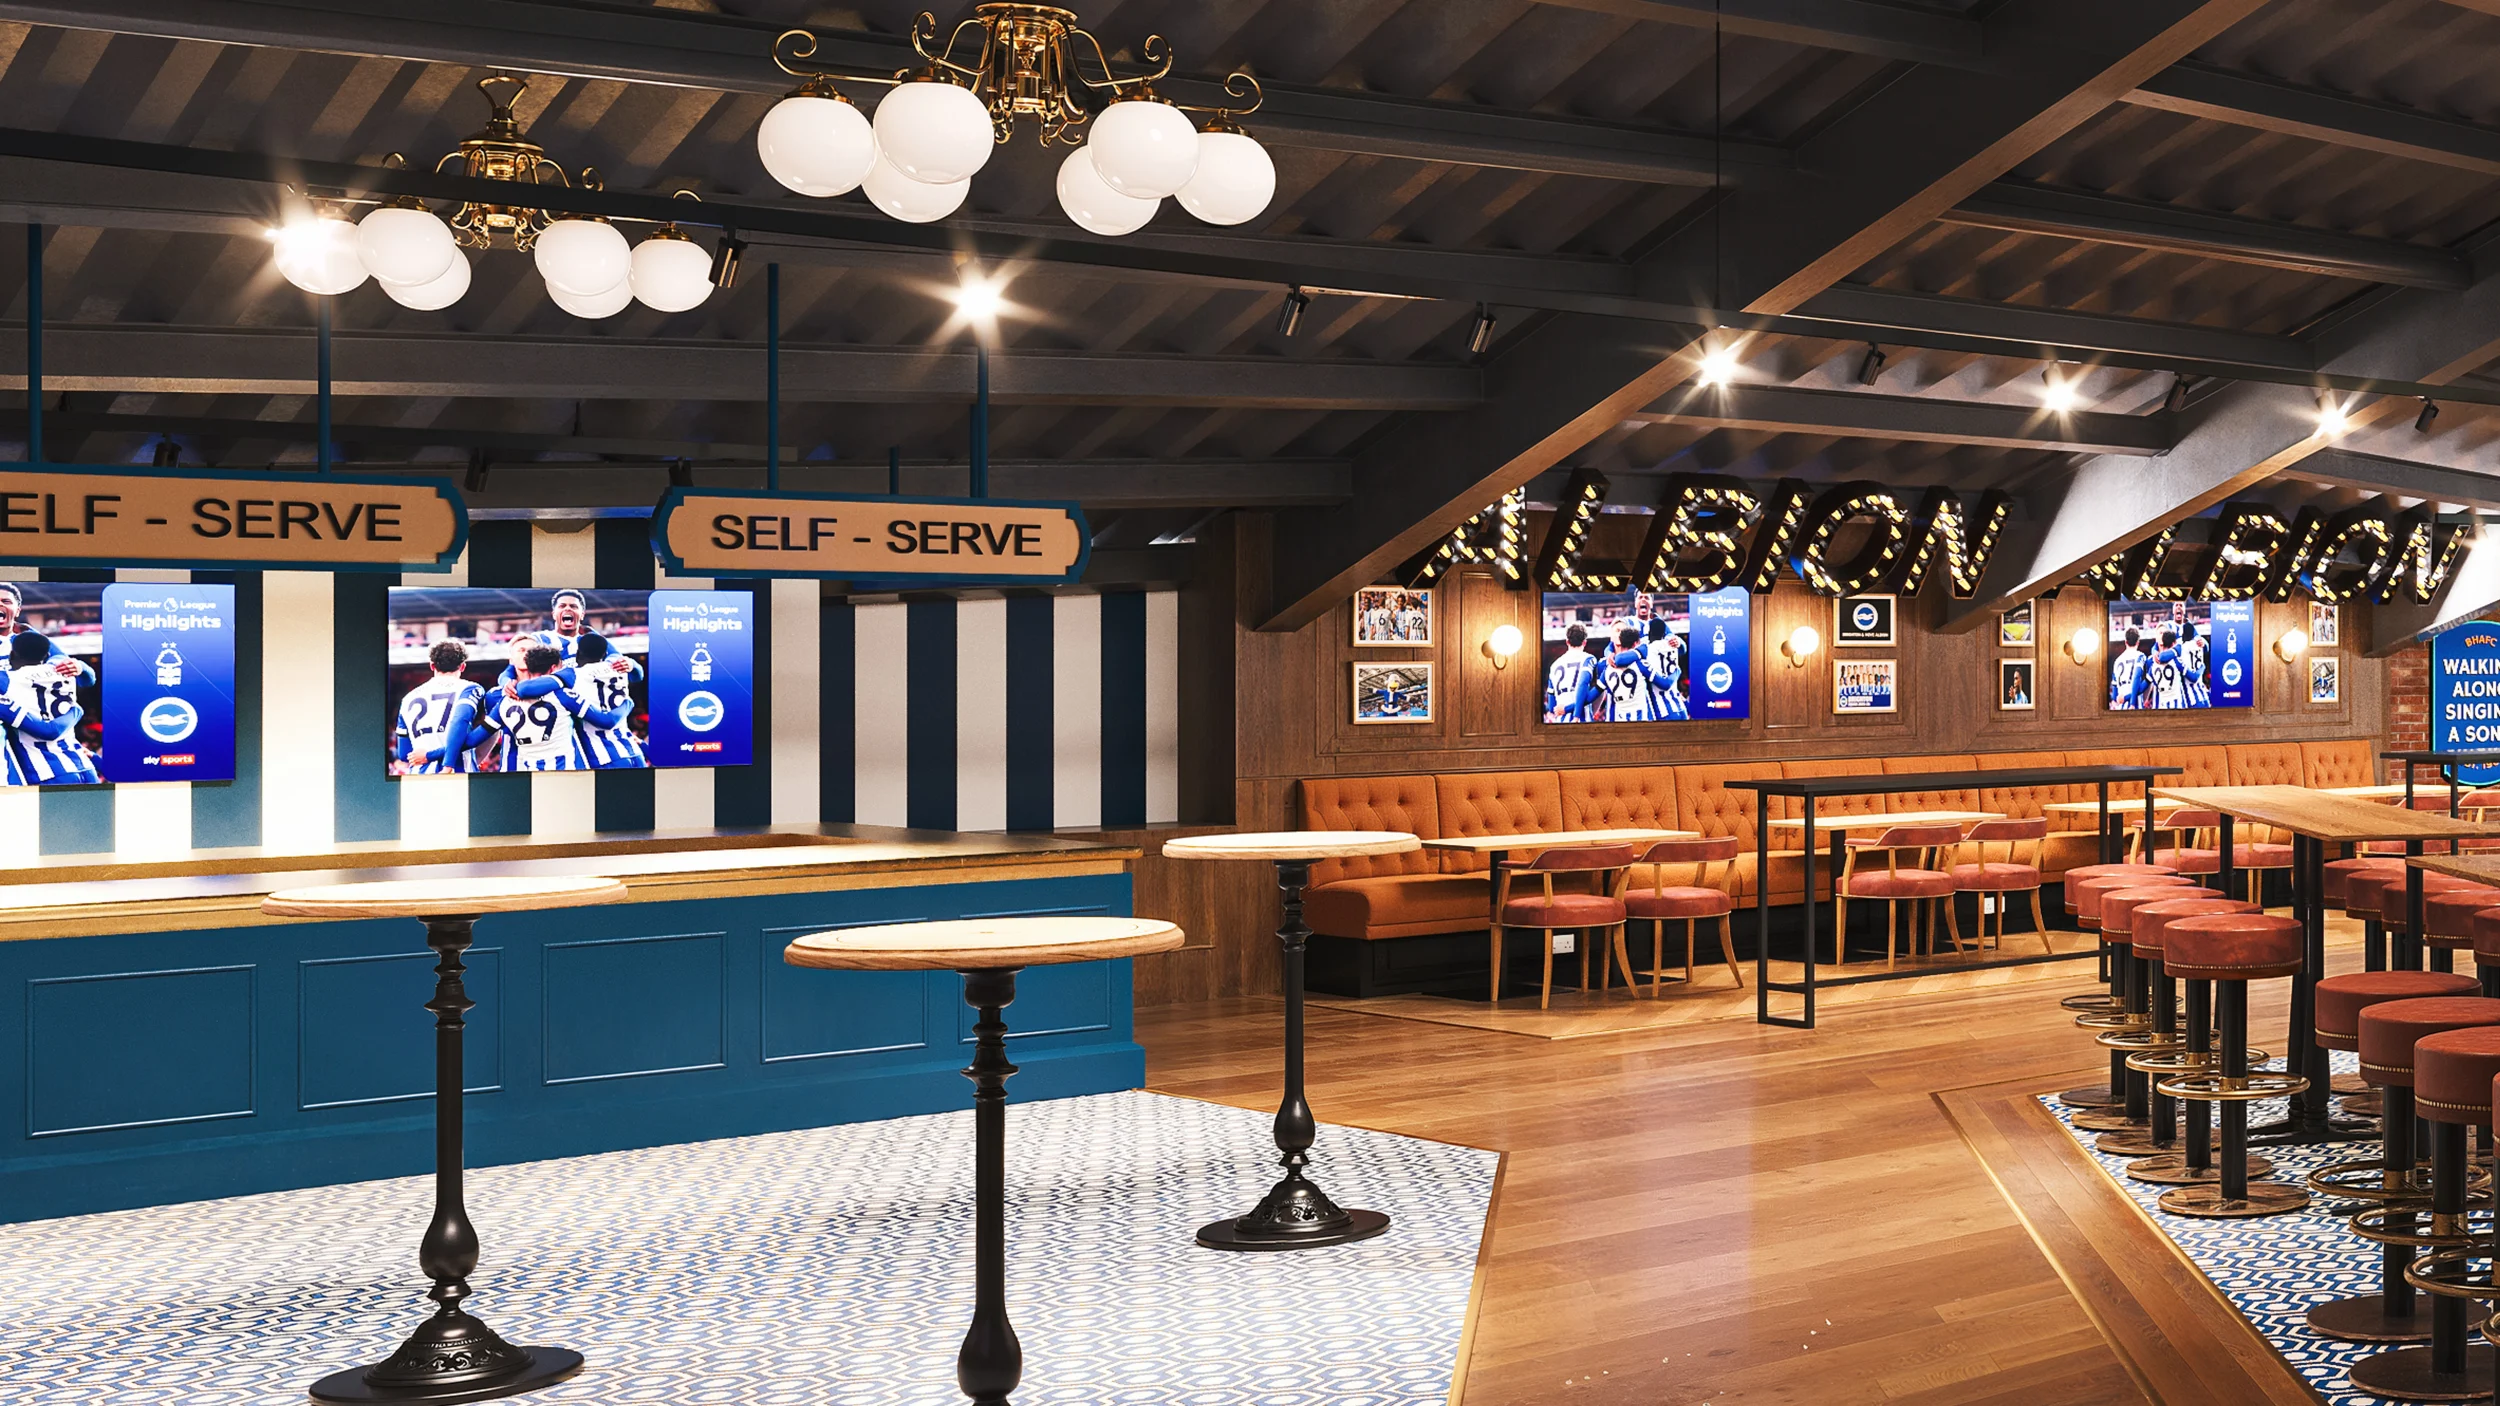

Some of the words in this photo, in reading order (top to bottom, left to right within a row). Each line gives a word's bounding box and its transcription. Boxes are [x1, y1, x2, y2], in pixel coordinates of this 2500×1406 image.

[191, 498, 403, 541] SERVE
[711, 514, 838, 552] SELF
[887, 520, 1043, 556] SERVE
[1402, 474, 2014, 599] ALBION
[2078, 508, 2472, 606] LBION
[124, 600, 162, 609] Premier
[180, 600, 216, 611] League
[665, 605, 695, 613] Premier
[709, 605, 739, 615] League
[121, 614, 222, 631] Highlights
[663, 618, 743, 632] Highlights
[2464, 635, 2498, 648] BHAFC
[2117, 659, 2135, 687] 27
[2443, 658, 2500, 675] WALKI
[1554, 661, 1581, 696] 27
[1608, 668, 1638, 702] 29
[2155, 664, 2175, 692] 29
[2453, 681, 2500, 697] ALON
[408, 692, 456, 739] 27
[506, 700, 558, 745] 29
[2448, 726, 2460, 743] A
[695, 743, 722, 751] sports
[143, 755, 160, 765] sky
[162, 755, 194, 765] sports
